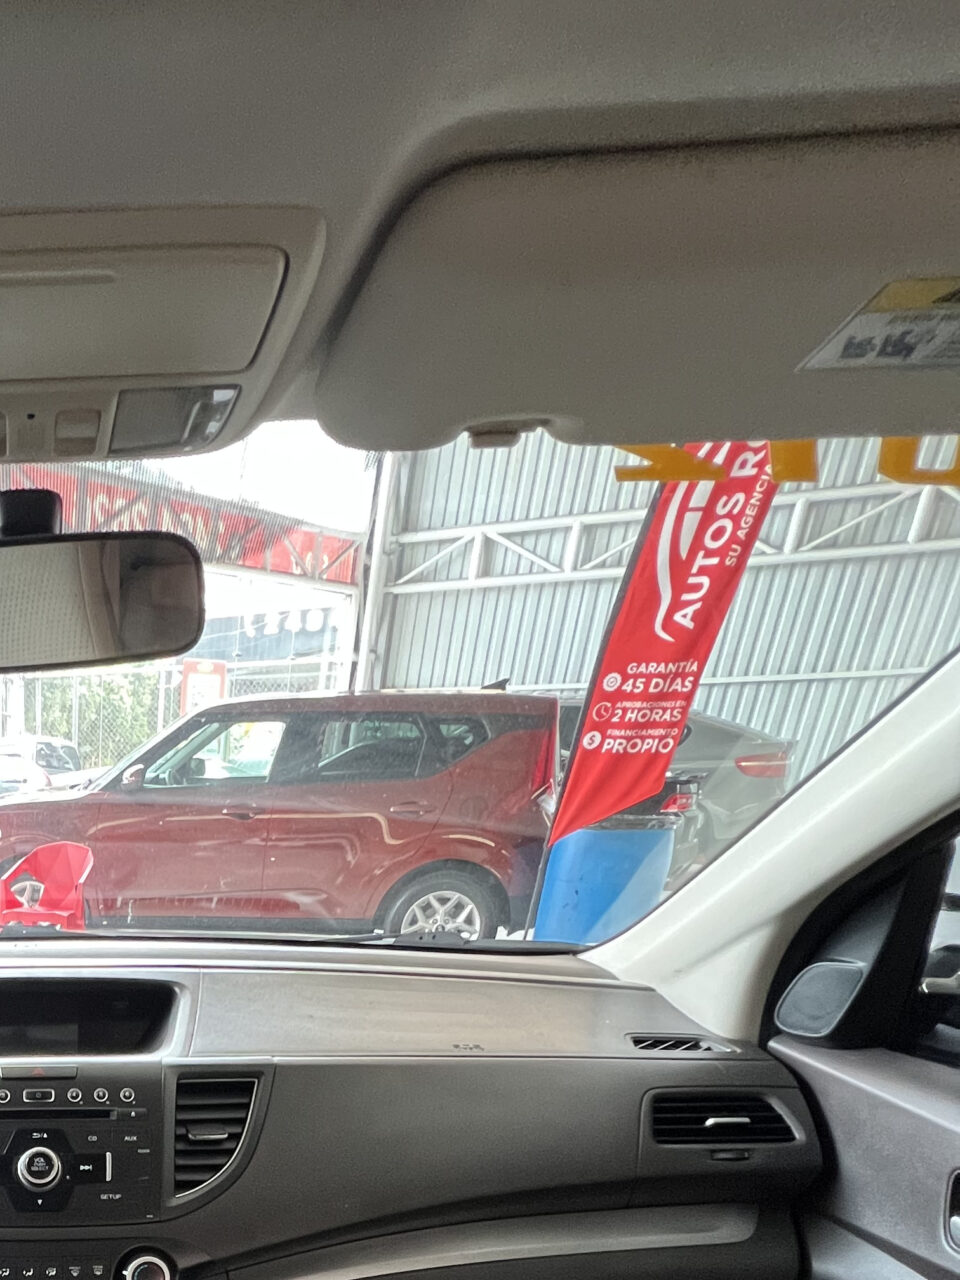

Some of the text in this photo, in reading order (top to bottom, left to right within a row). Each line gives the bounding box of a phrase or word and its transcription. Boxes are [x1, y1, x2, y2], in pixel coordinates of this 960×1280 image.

[725, 464, 773, 567] SU AGENCIA
[672, 492, 746, 630] AUTOS
[626, 658, 699, 674] GARANTÍA
[621, 674, 695, 693] 45 DÍAS
[615, 701, 675, 709] APROBACIONES
[611, 708, 683, 722] 2 HORAS
[606, 728, 679, 736] FINANCIAMIENTO
